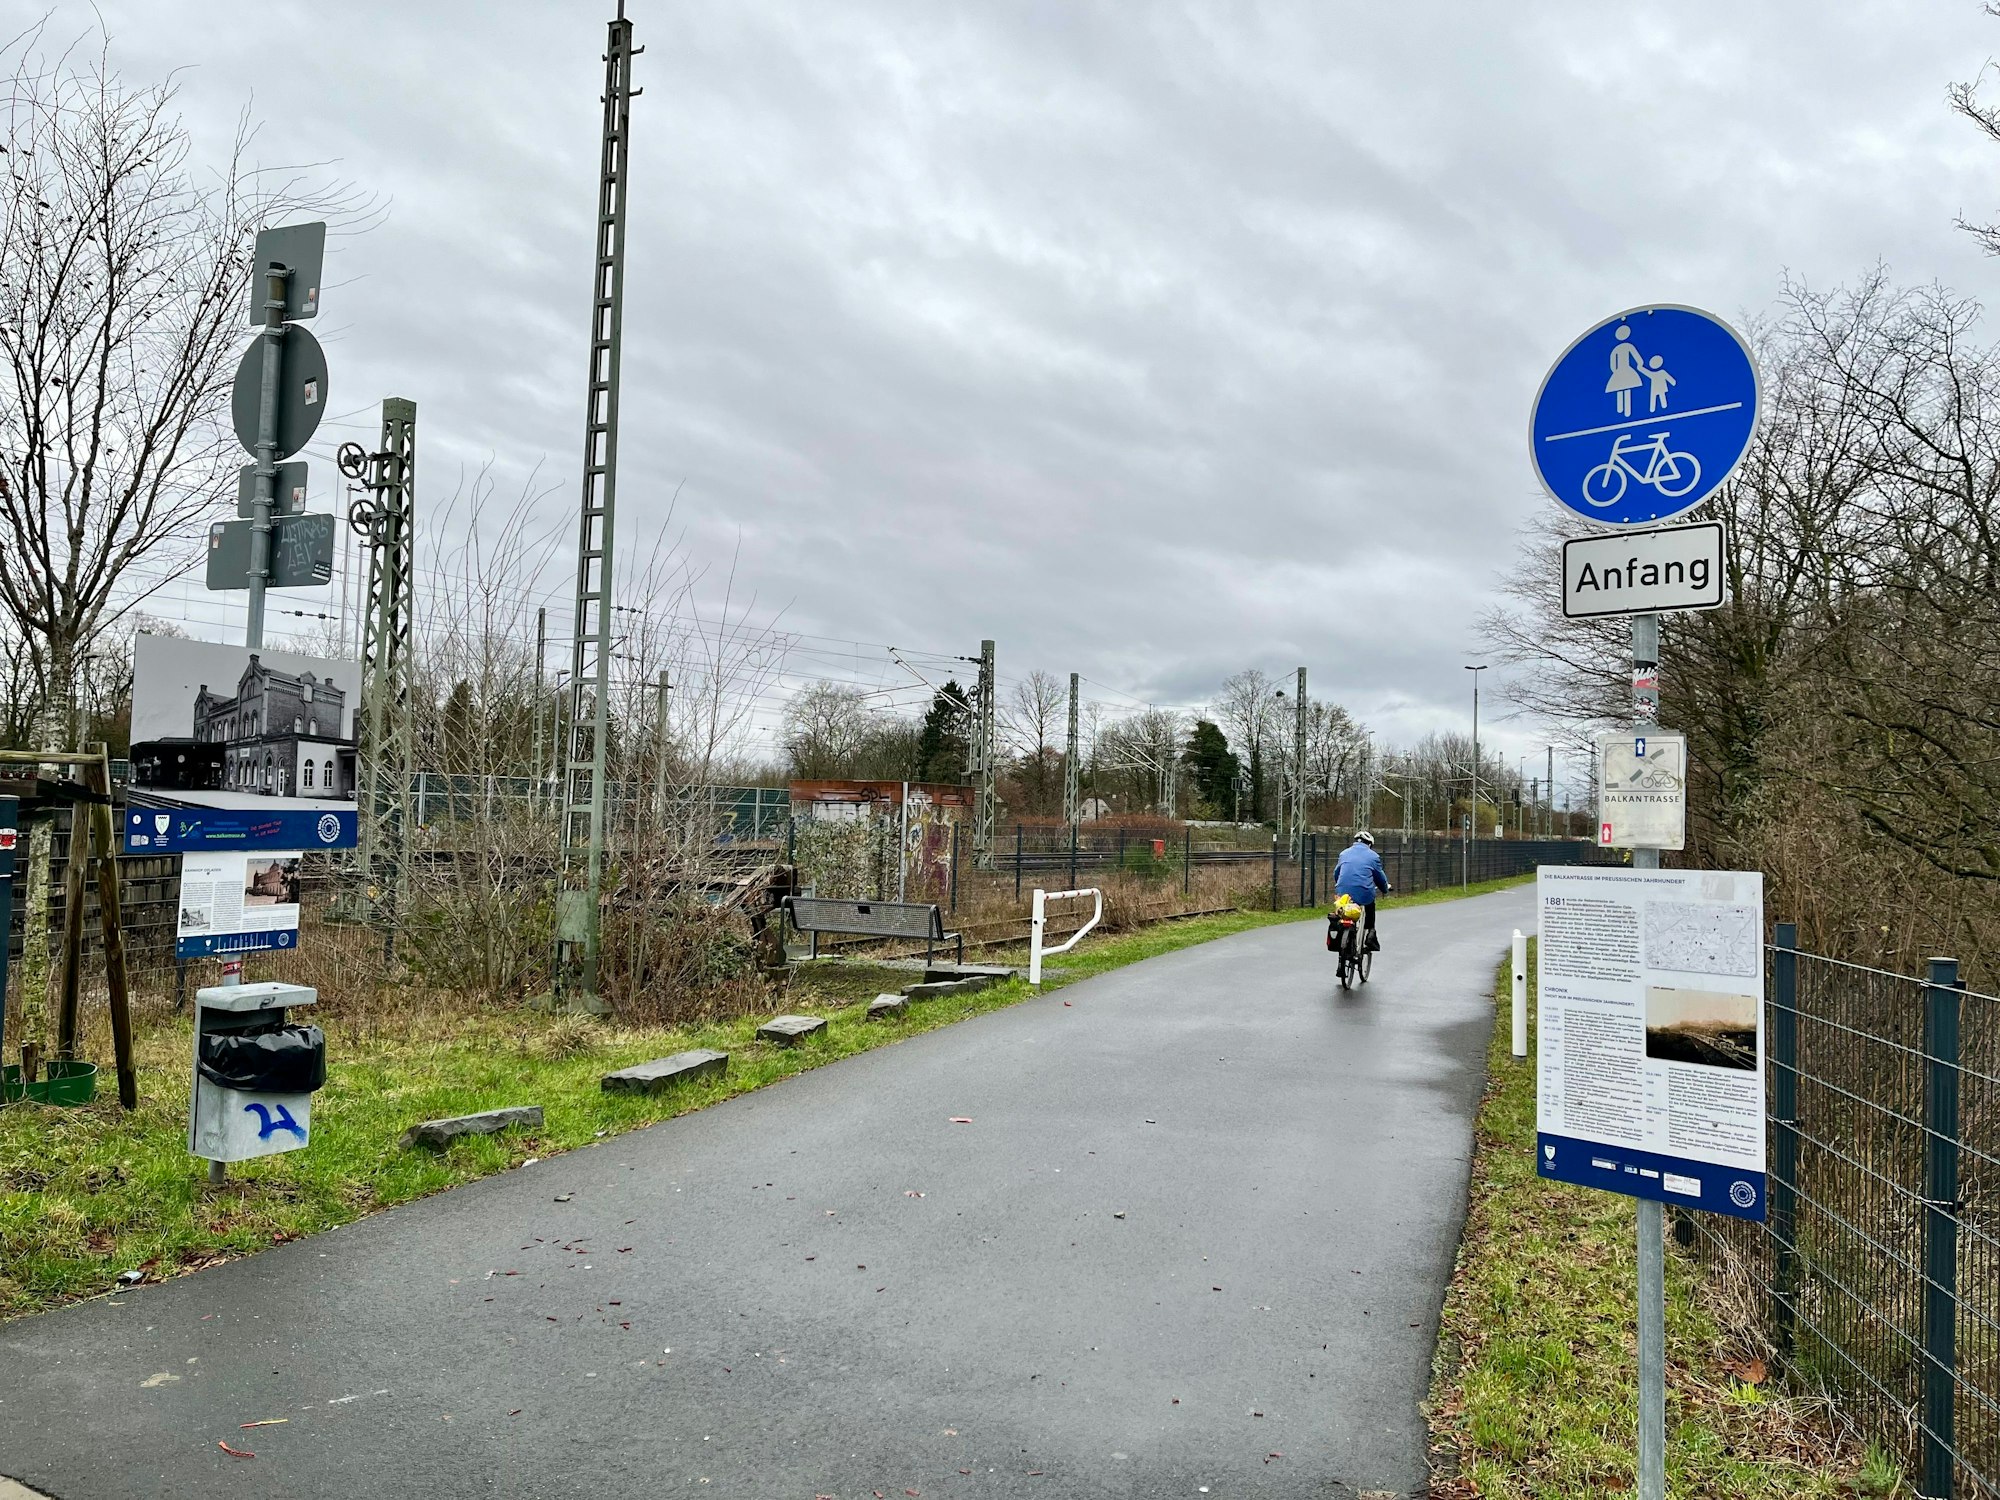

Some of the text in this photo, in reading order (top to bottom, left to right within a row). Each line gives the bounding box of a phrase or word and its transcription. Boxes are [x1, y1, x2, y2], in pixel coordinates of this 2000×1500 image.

[1576, 557, 1709, 593] Anfang
[1605, 795, 1680, 803] BALKANTRASSE
[1545, 897, 1566, 906] 1881
